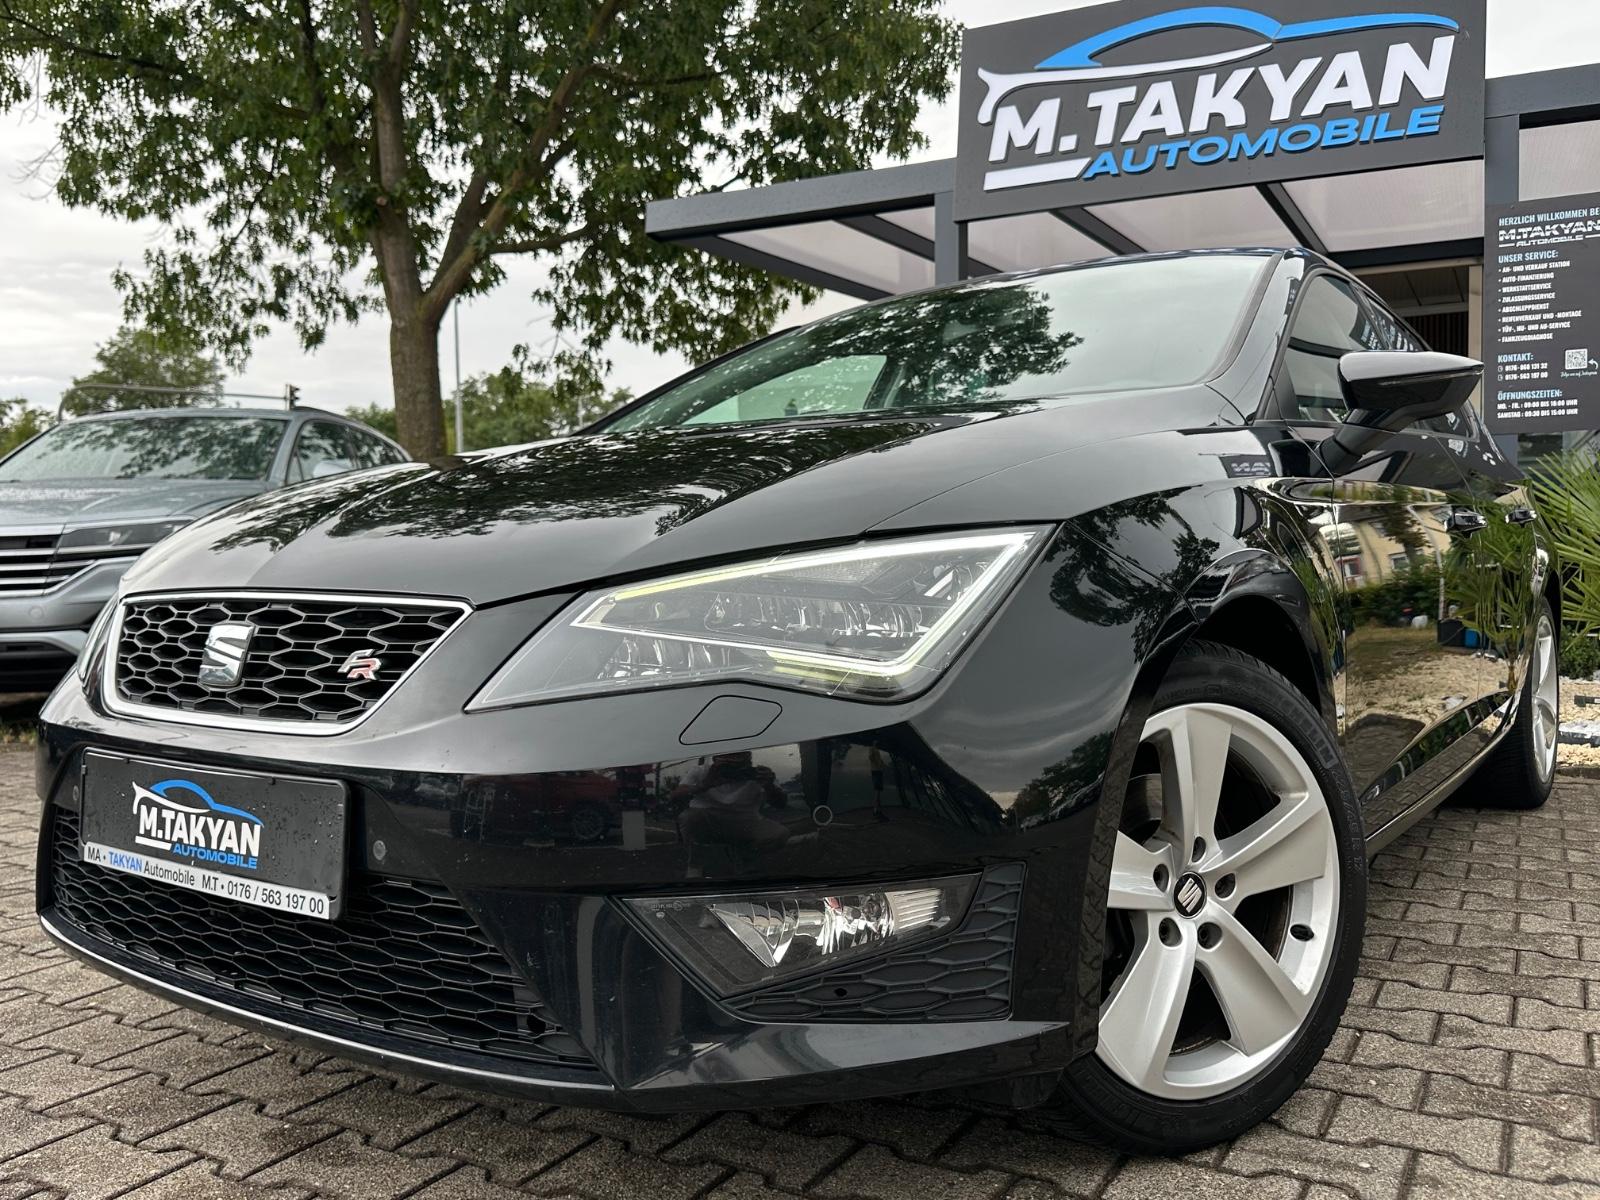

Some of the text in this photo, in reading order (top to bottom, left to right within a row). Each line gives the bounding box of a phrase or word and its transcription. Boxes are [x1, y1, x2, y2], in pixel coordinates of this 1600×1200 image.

[988, 36, 1454, 162] M.TAKYAN
[1083, 105, 1445, 179] AUTOMOBILE
[1499, 215, 1535, 226] HERZLICH
[1537, 209, 1588, 221] WILLKOMMEN
[1516, 235, 1583, 247] AUTOMOBILE
[1498, 250, 1558, 263] UNSER SERVICE:
[1498, 353, 1533, 362] KONTAKT:
[1497, 389, 1563, 400] ÖFFNUNGSZEITEN:
[337, 649, 382, 681] FR
[139, 804, 262, 857] M.TAKYAN
[172, 843, 258, 870] AUTOMOBILE
[87, 846, 101, 861] MA
[108, 850, 142, 873] TAKYAN
[143, 860, 195, 886] Automobile
[201, 873, 219, 892] M.T
[227, 881, 252, 900] 0176
[261, 889, 282, 907] 563
[285, 894, 305, 911] 197
[309, 898, 324, 915] 00
